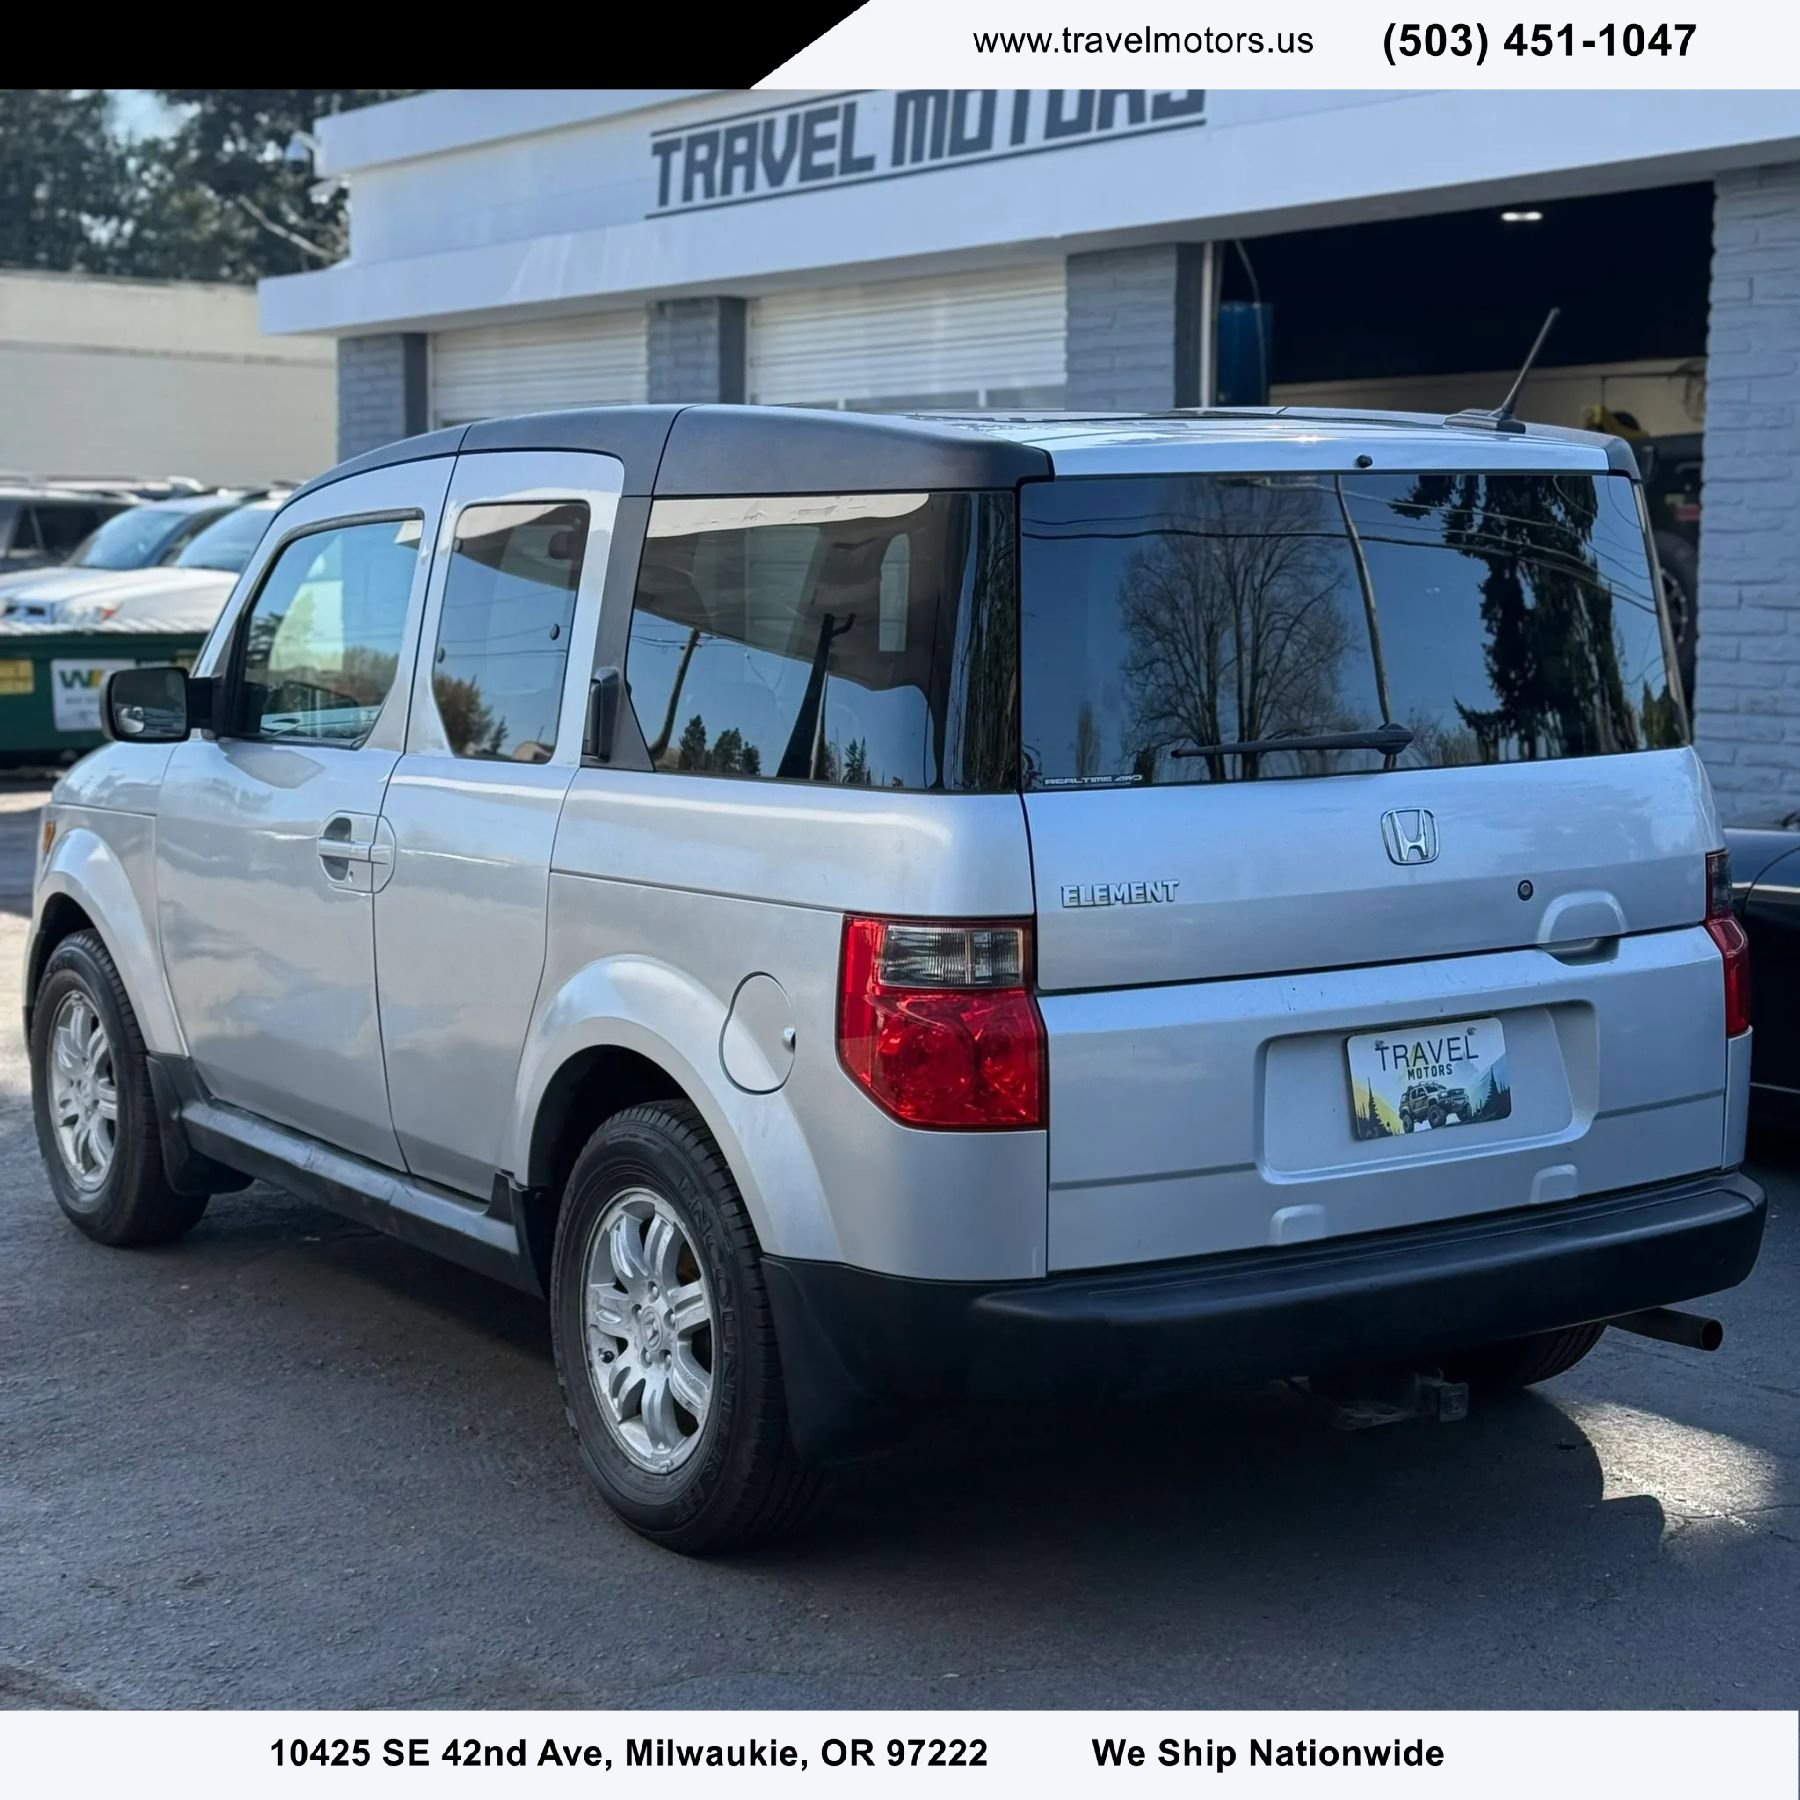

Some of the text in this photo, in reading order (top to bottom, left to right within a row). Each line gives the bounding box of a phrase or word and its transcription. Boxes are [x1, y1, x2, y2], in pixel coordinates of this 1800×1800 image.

[652, 101, 876, 208] TRAVEL
[1061, 879, 1180, 908] ELEMENT
[1374, 1034, 1479, 1071] TRAVEL
[1407, 1063, 1453, 1081] MOTORS
